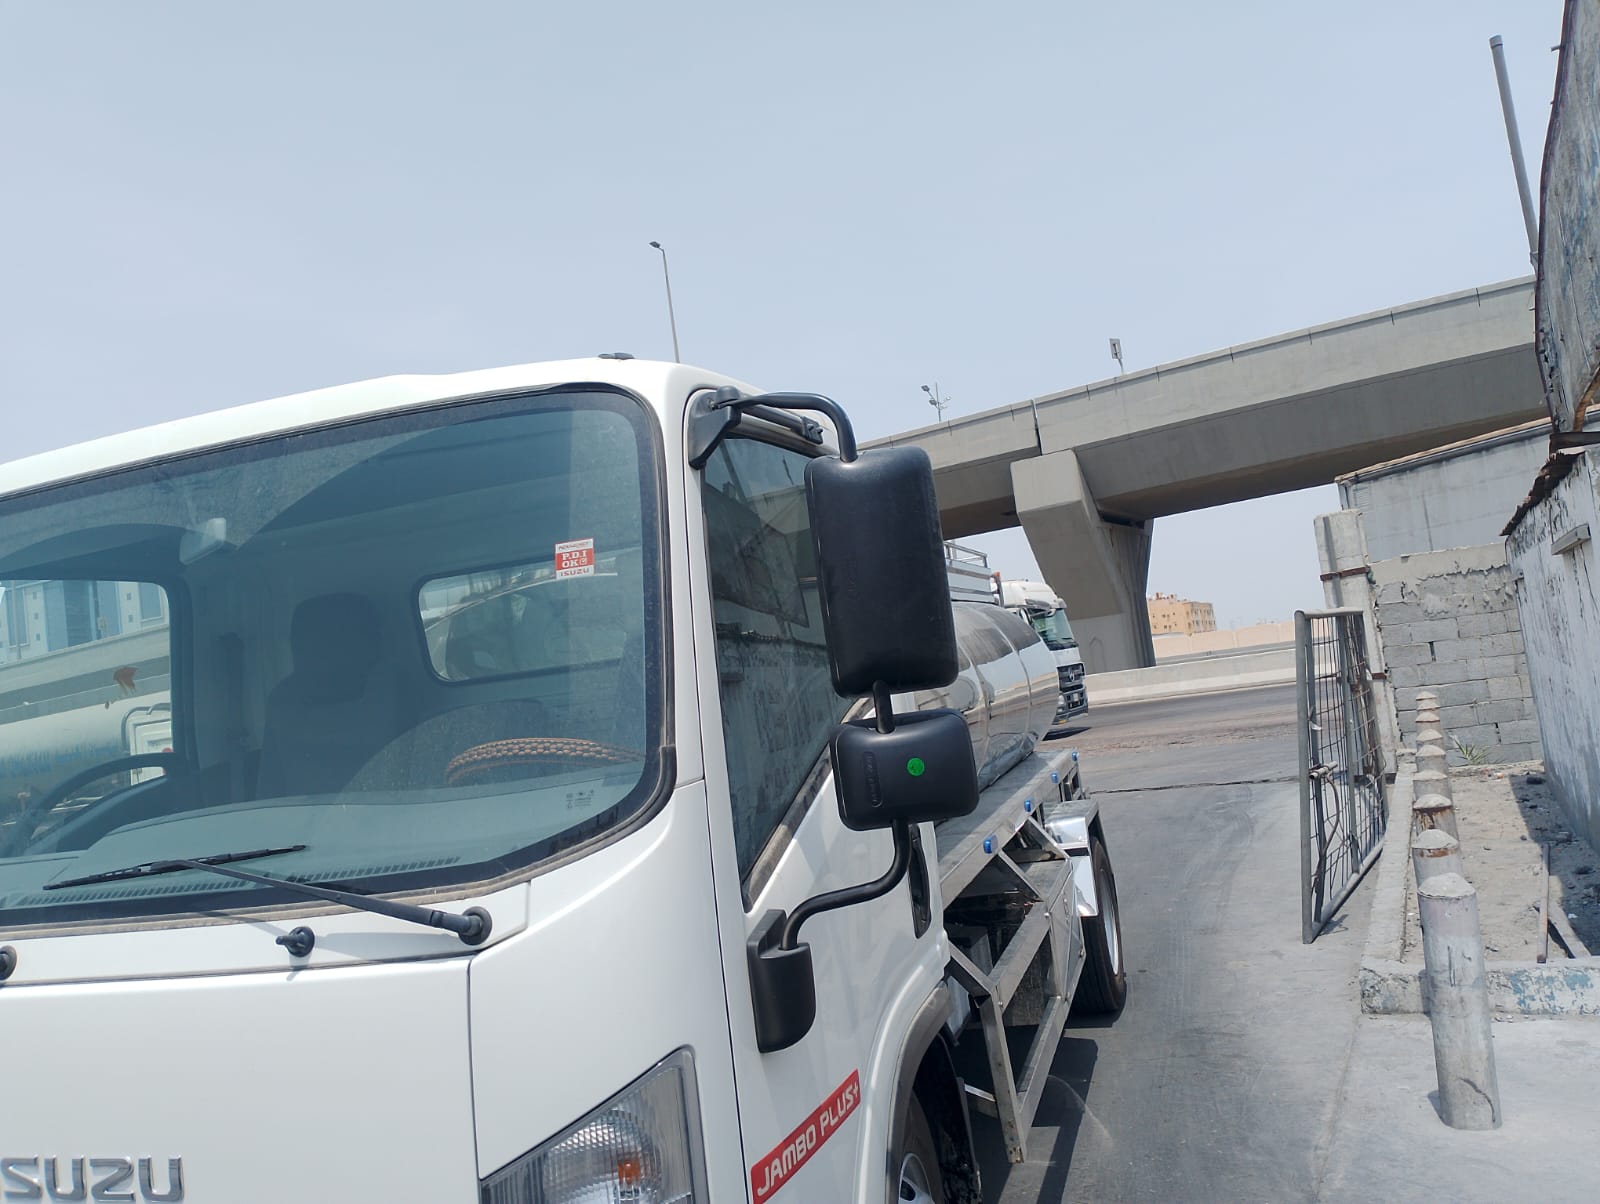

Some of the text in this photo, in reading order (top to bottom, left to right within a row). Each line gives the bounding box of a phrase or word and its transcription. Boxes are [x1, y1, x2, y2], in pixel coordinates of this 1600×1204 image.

[560, 568, 590, 577] ISUZU
[562, 560, 578, 568] OK
[757, 1124, 816, 1197] JAMBO
[0, 1155, 184, 1202] SUZU
